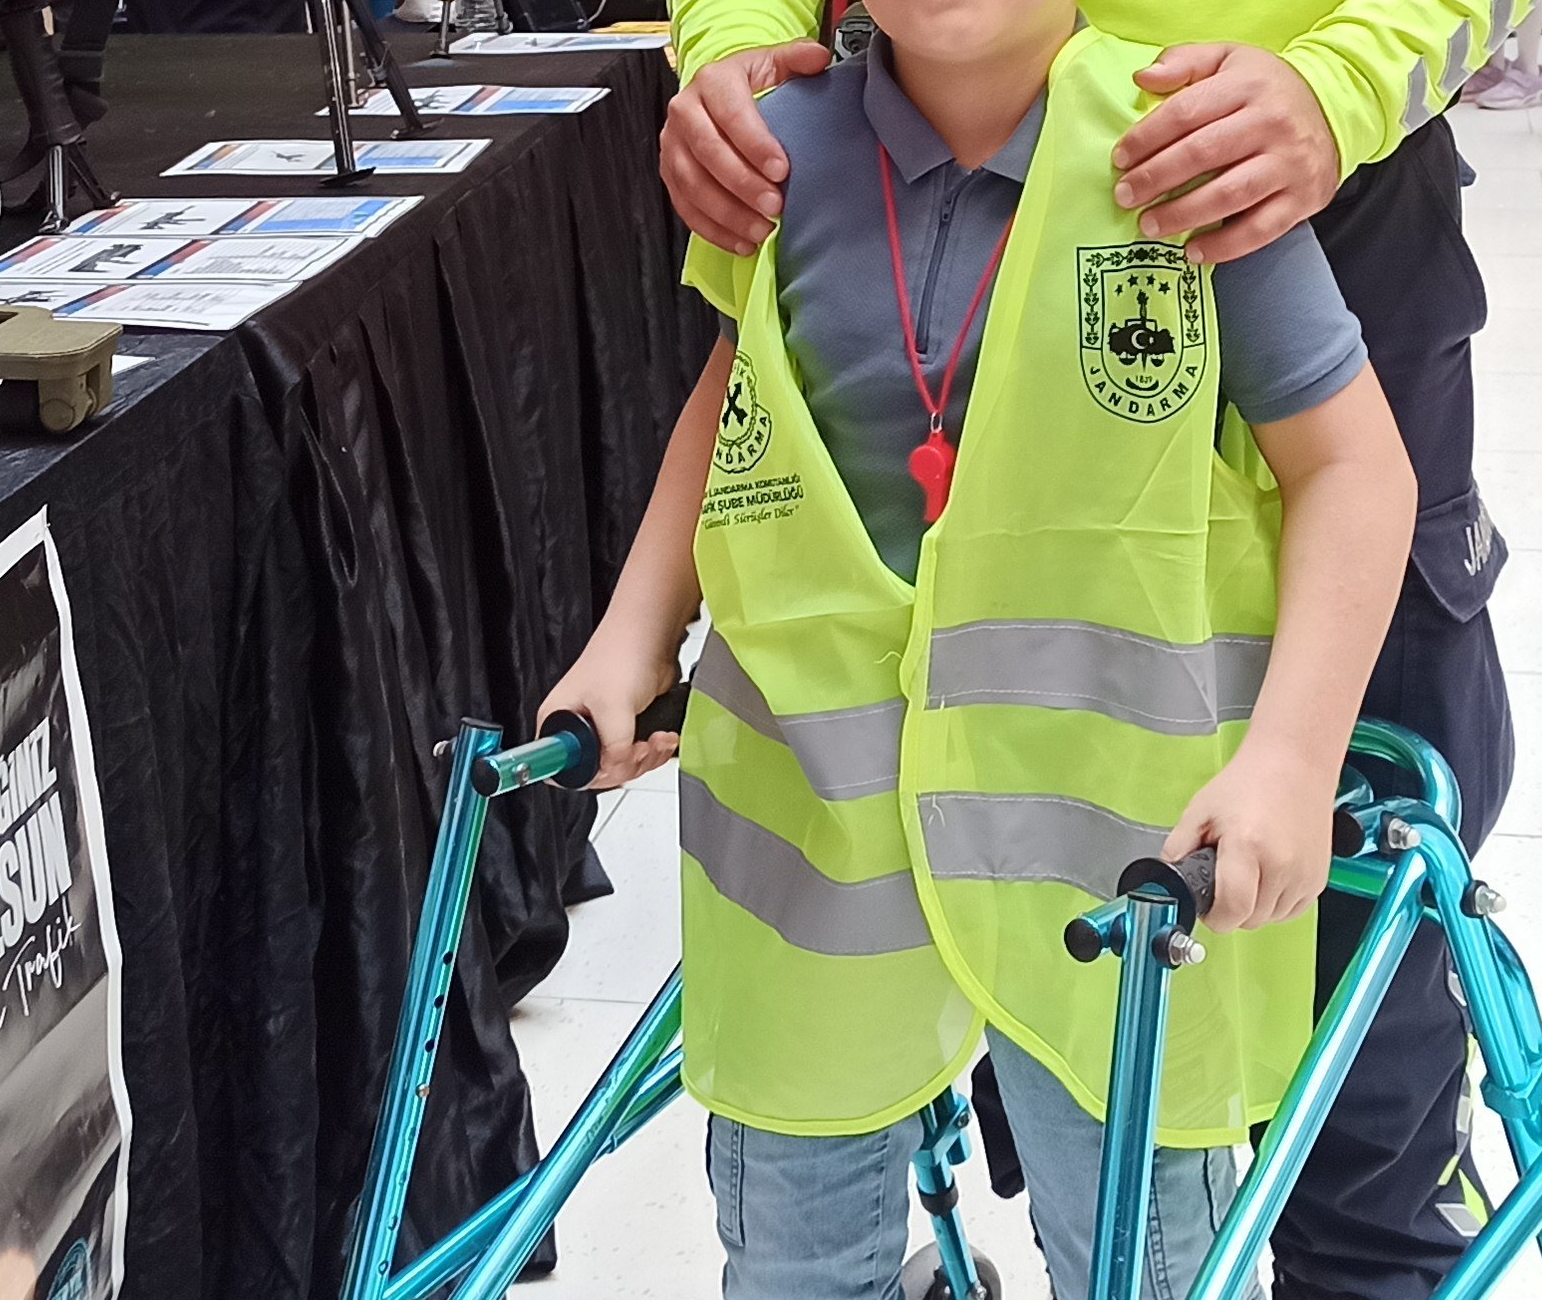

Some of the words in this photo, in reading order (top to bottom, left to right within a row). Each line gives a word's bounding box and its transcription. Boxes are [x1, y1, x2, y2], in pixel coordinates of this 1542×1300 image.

[1090, 365, 1198, 417] JANDARMA
[716, 415, 769, 464] NDARMA
[718, 496, 745, 513] ŞUBE
[746, 484, 804, 507] MÜDÜRLÜĞÜ
[2, 895, 82, 1018] Trafik
